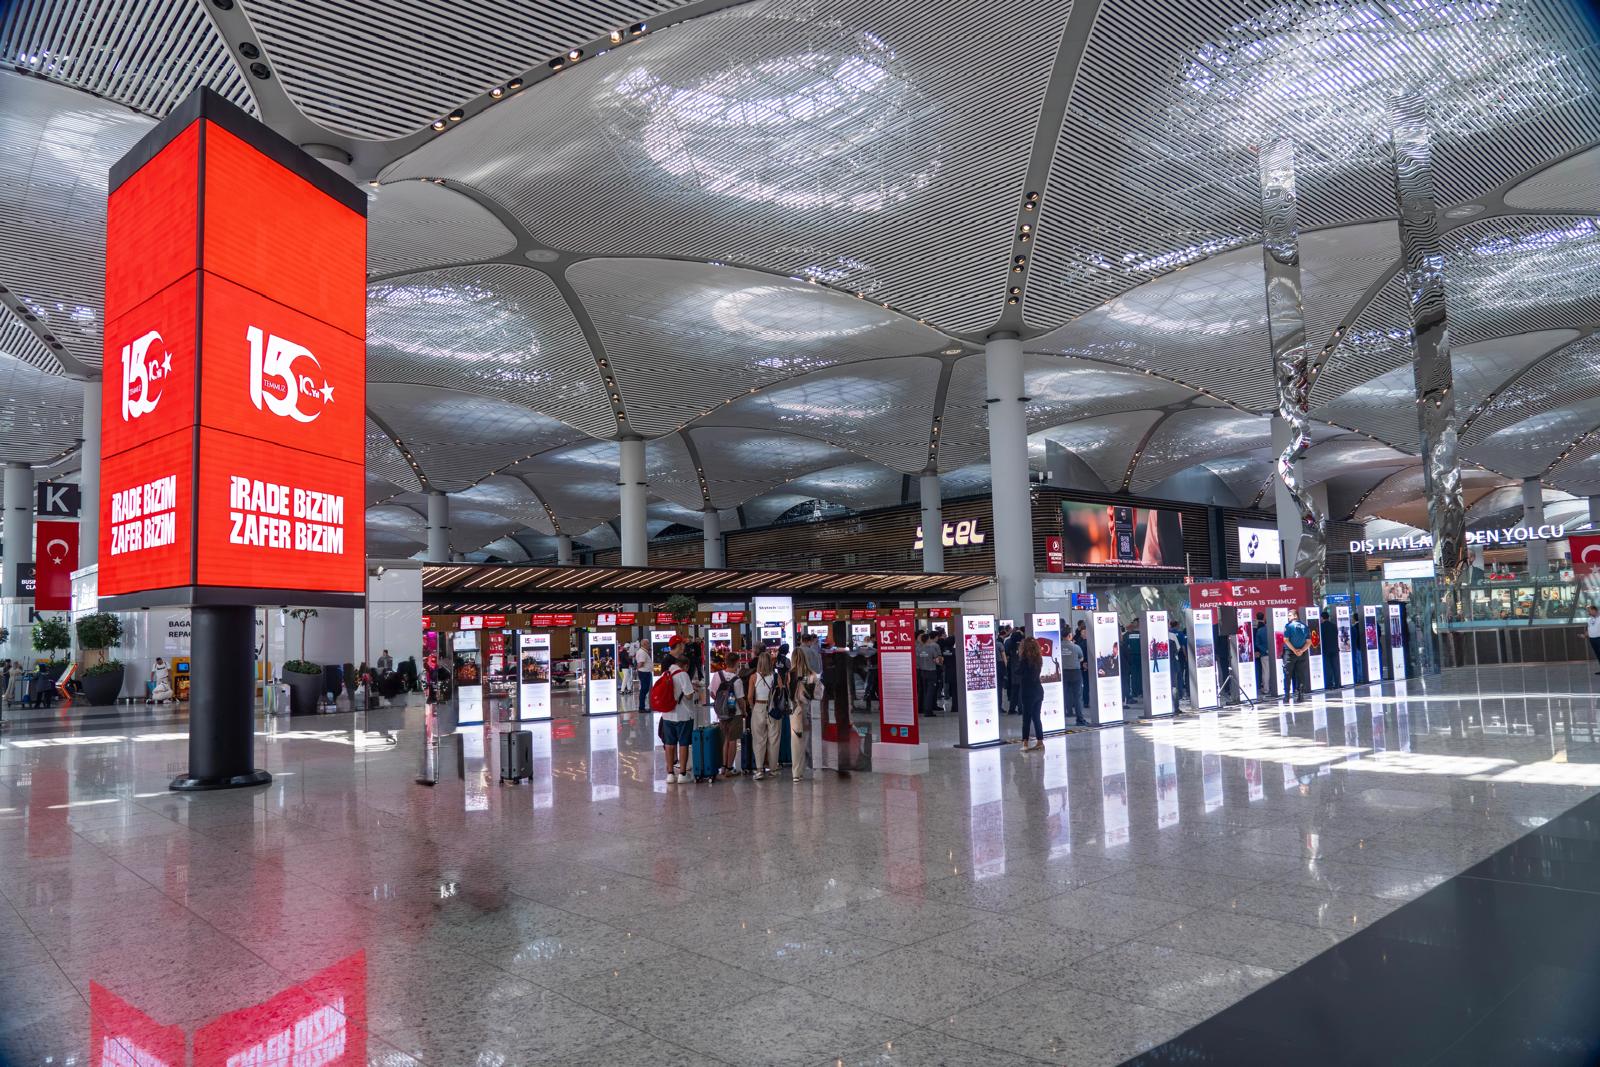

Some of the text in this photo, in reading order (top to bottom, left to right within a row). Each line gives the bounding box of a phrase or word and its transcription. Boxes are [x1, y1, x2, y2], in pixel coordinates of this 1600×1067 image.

[122, 330, 155, 422] 15
[246, 325, 306, 421] 15
[264, 378, 286, 393] TEMMUZ
[46, 486, 69, 513] K
[111, 518, 142, 556] ZAFER
[229, 511, 291, 549] ZAFER
[1349, 539, 1375, 555] DIŞ
[1502, 524, 1565, 542] YOLCU
